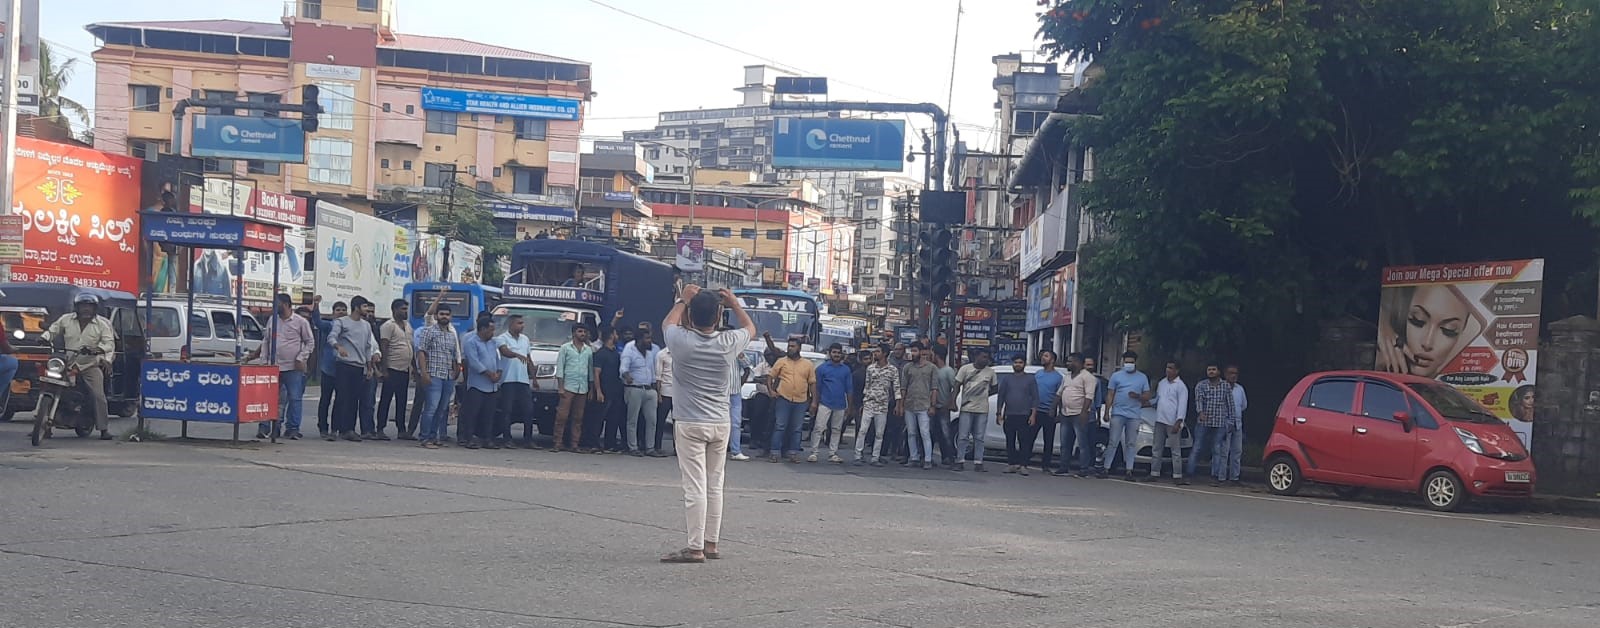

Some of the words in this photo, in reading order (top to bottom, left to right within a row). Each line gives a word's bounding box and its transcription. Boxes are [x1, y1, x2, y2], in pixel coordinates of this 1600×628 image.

[261, 191, 279, 207] Book
[280, 195, 296, 212] Now!
[24, 248, 58, 265] ದ್ಯಾವರ
[1387, 269, 1403, 281] Join
[1405, 270, 1417, 279] our
[1420, 266, 1441, 281] Mega
[1442, 265, 1472, 280] Special
[1474, 264, 1494, 277] offer
[1496, 265, 1513, 276] now
[99, 279, 121, 289] 10477
[198, 372, 233, 386] ಧರಿಸಿ
[144, 396, 188, 412] ವಾಹನ
[195, 400, 231, 415] ಚಲಿಸಿ
